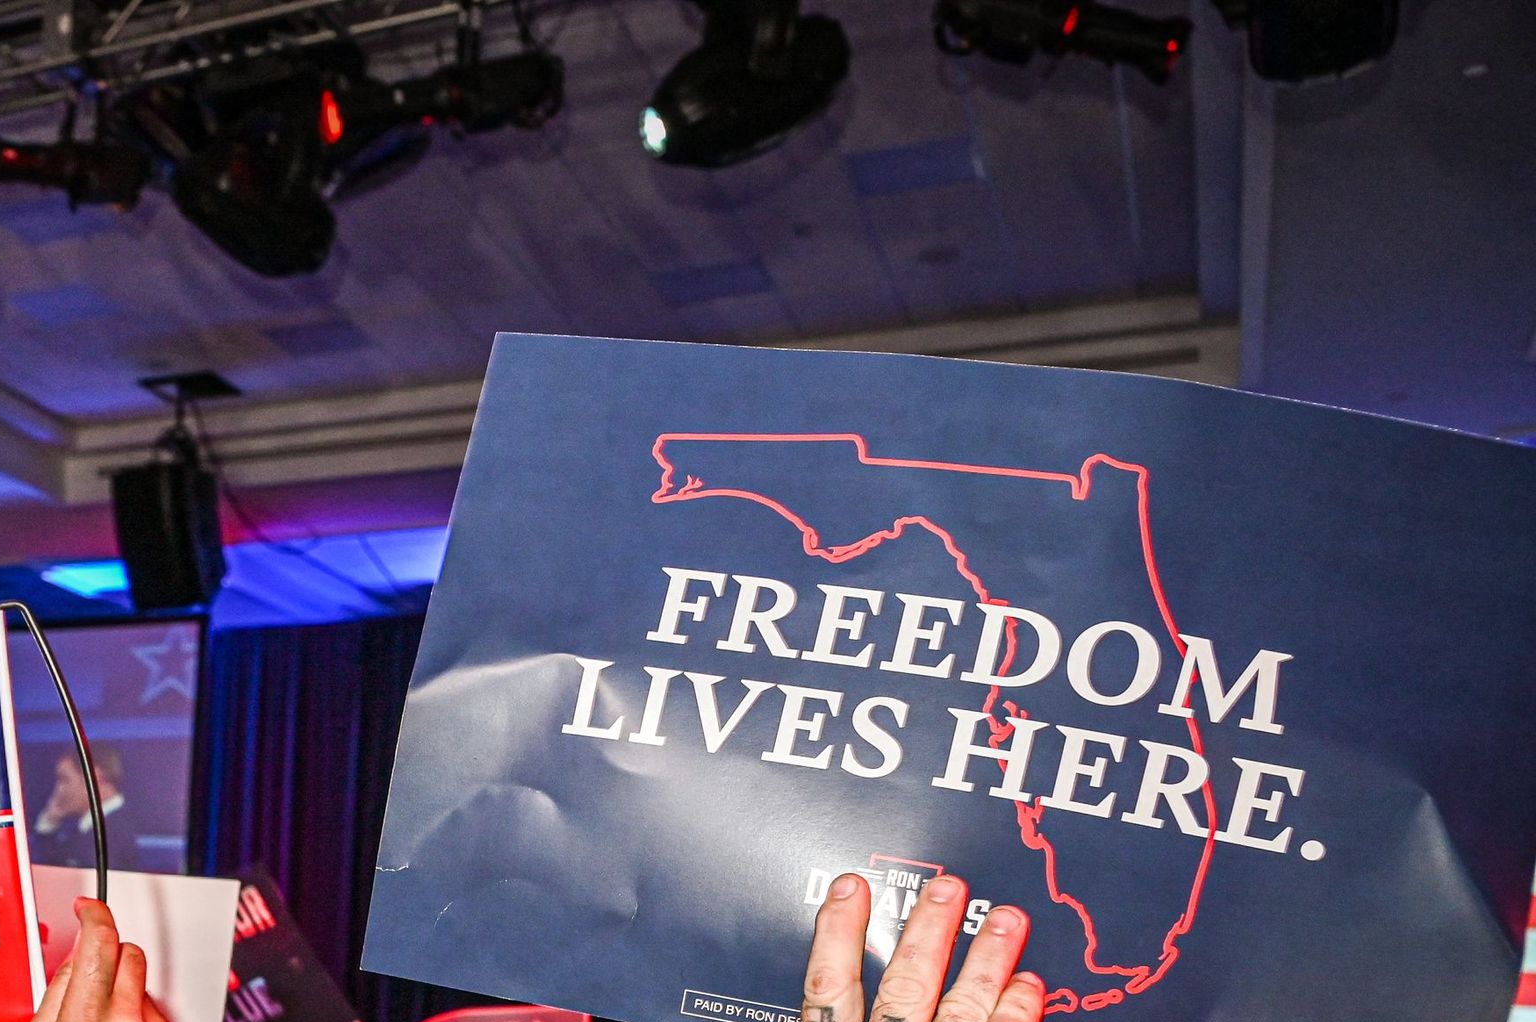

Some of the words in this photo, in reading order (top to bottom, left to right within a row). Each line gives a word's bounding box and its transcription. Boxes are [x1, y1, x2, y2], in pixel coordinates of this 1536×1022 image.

[645, 566, 1295, 735] FREEDOM
[560, 656, 909, 779] LIVES
[931, 706, 1327, 862] HERE.
[886, 869, 921, 889] RON
[694, 998, 723, 1014] PAID
[725, 1004, 744, 1018] BY
